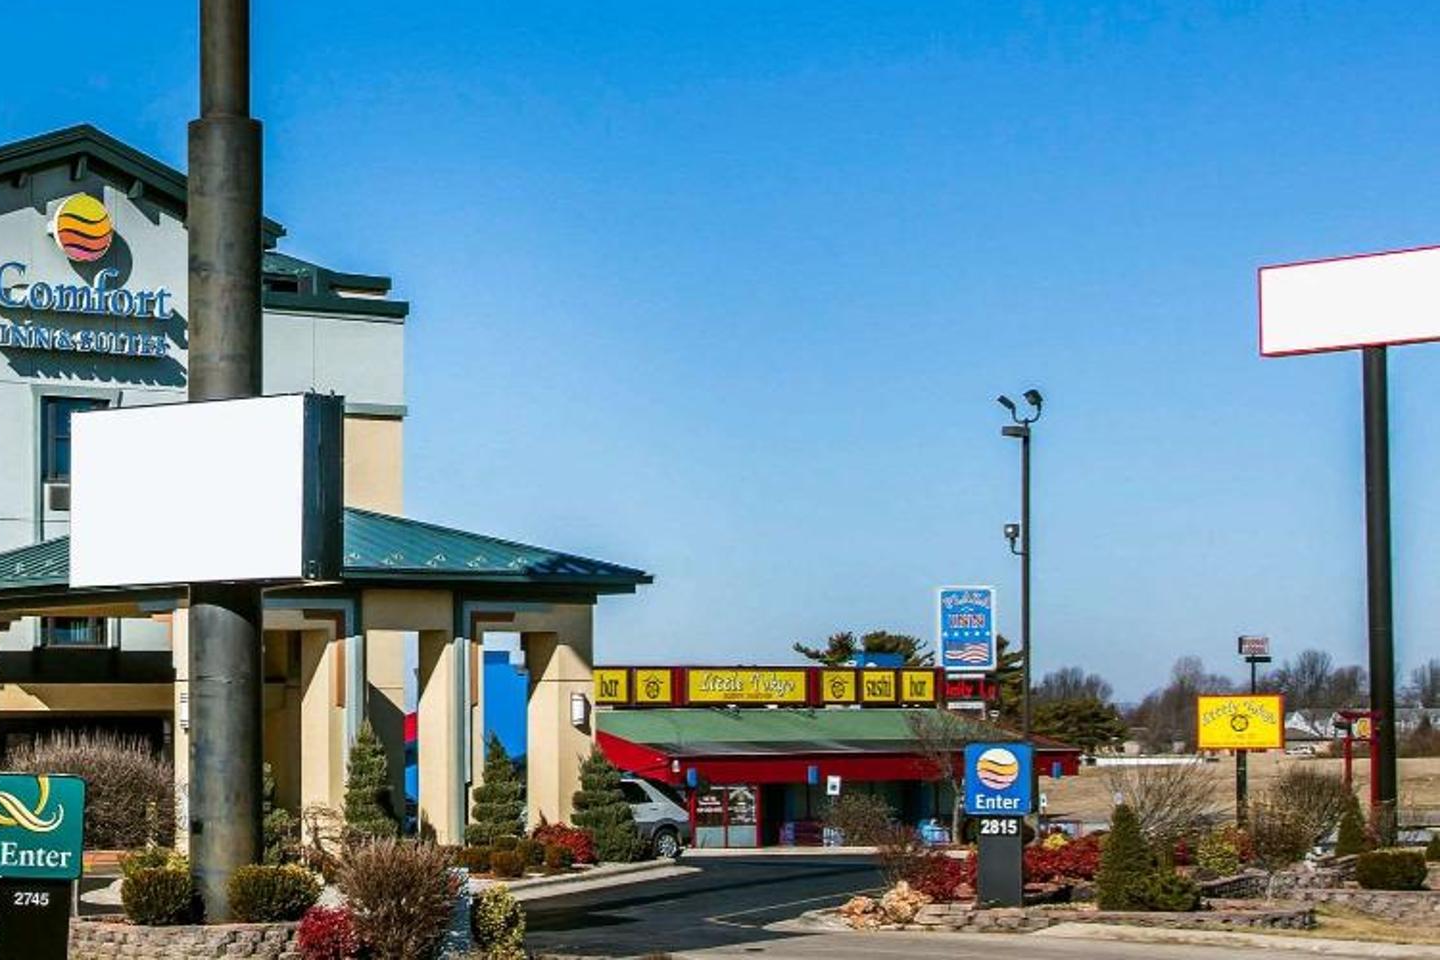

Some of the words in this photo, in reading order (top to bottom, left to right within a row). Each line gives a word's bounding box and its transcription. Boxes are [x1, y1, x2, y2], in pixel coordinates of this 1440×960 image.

[55, 328, 75, 350] &
[75, 328, 172, 356] SUITES
[599, 673, 619, 698] bar
[909, 674, 927, 697] bar
[975, 794, 1021, 809] Enter
[980, 819, 1018, 835] 2815
[0, 842, 72, 868] Enter
[13, 892, 50, 906] 2745
